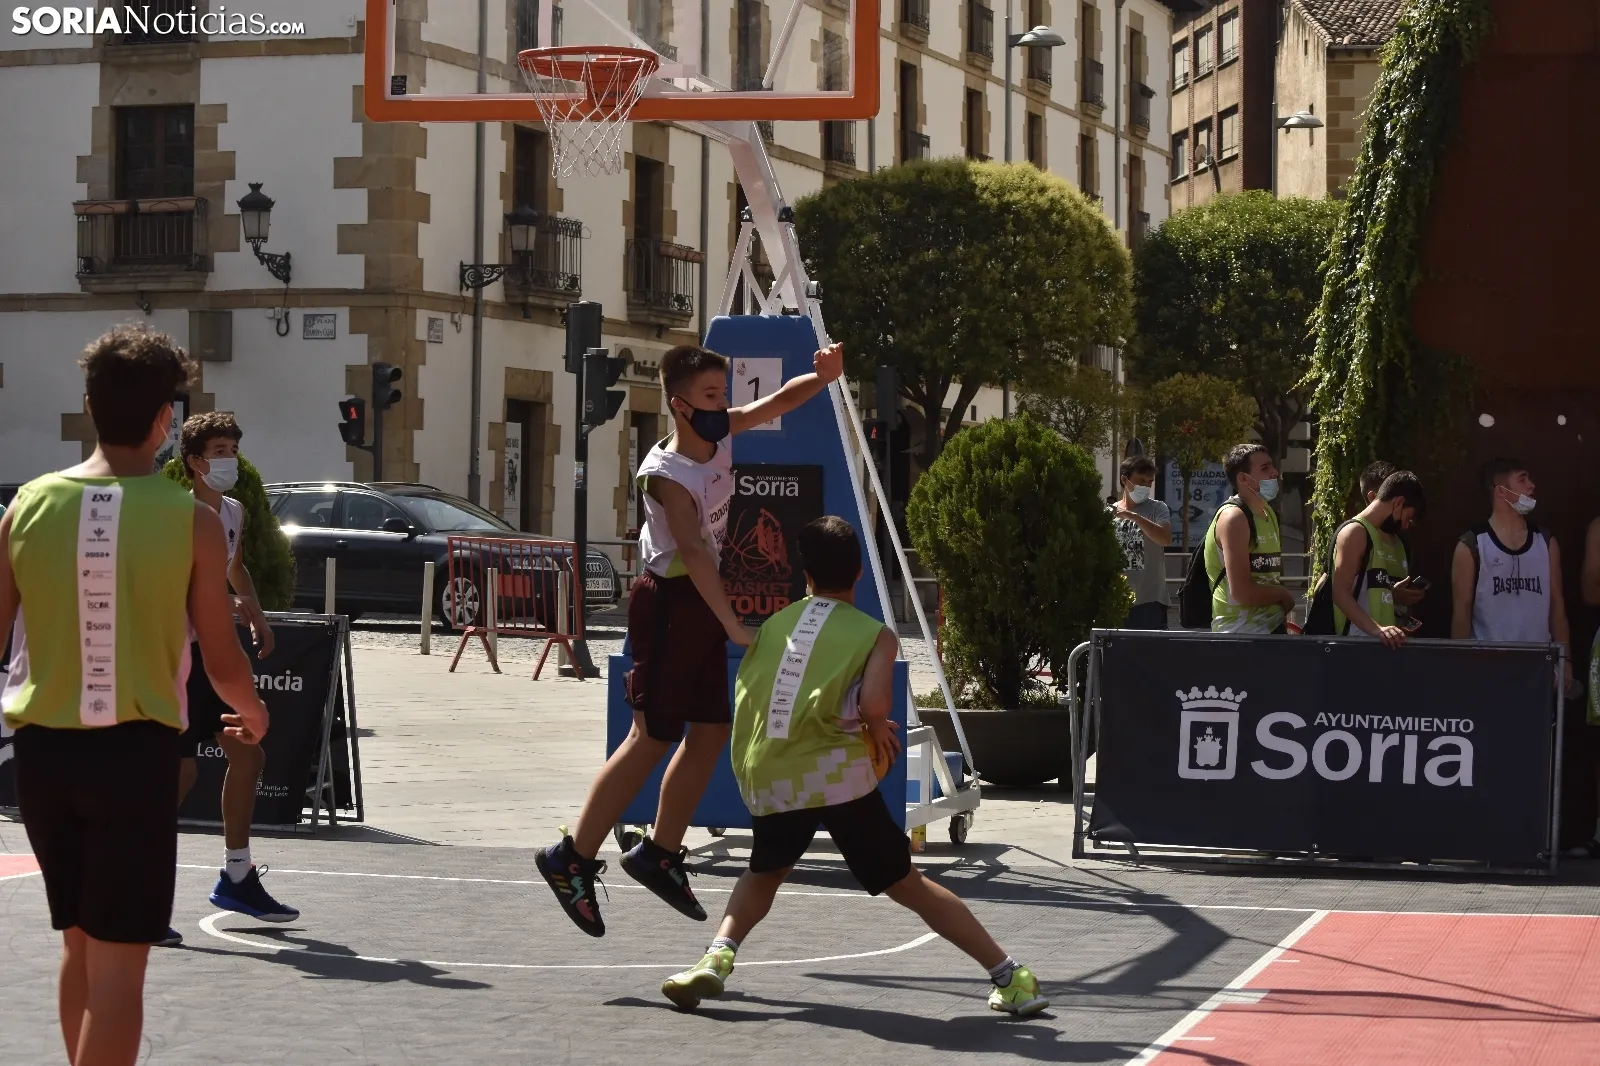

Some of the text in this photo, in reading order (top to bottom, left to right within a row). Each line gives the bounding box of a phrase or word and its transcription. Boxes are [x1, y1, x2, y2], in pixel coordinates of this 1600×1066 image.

[747, 376, 760, 402] 1
[1171, 470, 1227, 478] GRDUADAS
[738, 475, 799, 497] Soria
[723, 581, 793, 596] BASKET
[1313, 711, 1475, 733] AYUNTAMIENTO
[1250, 711, 1475, 787] Soria
